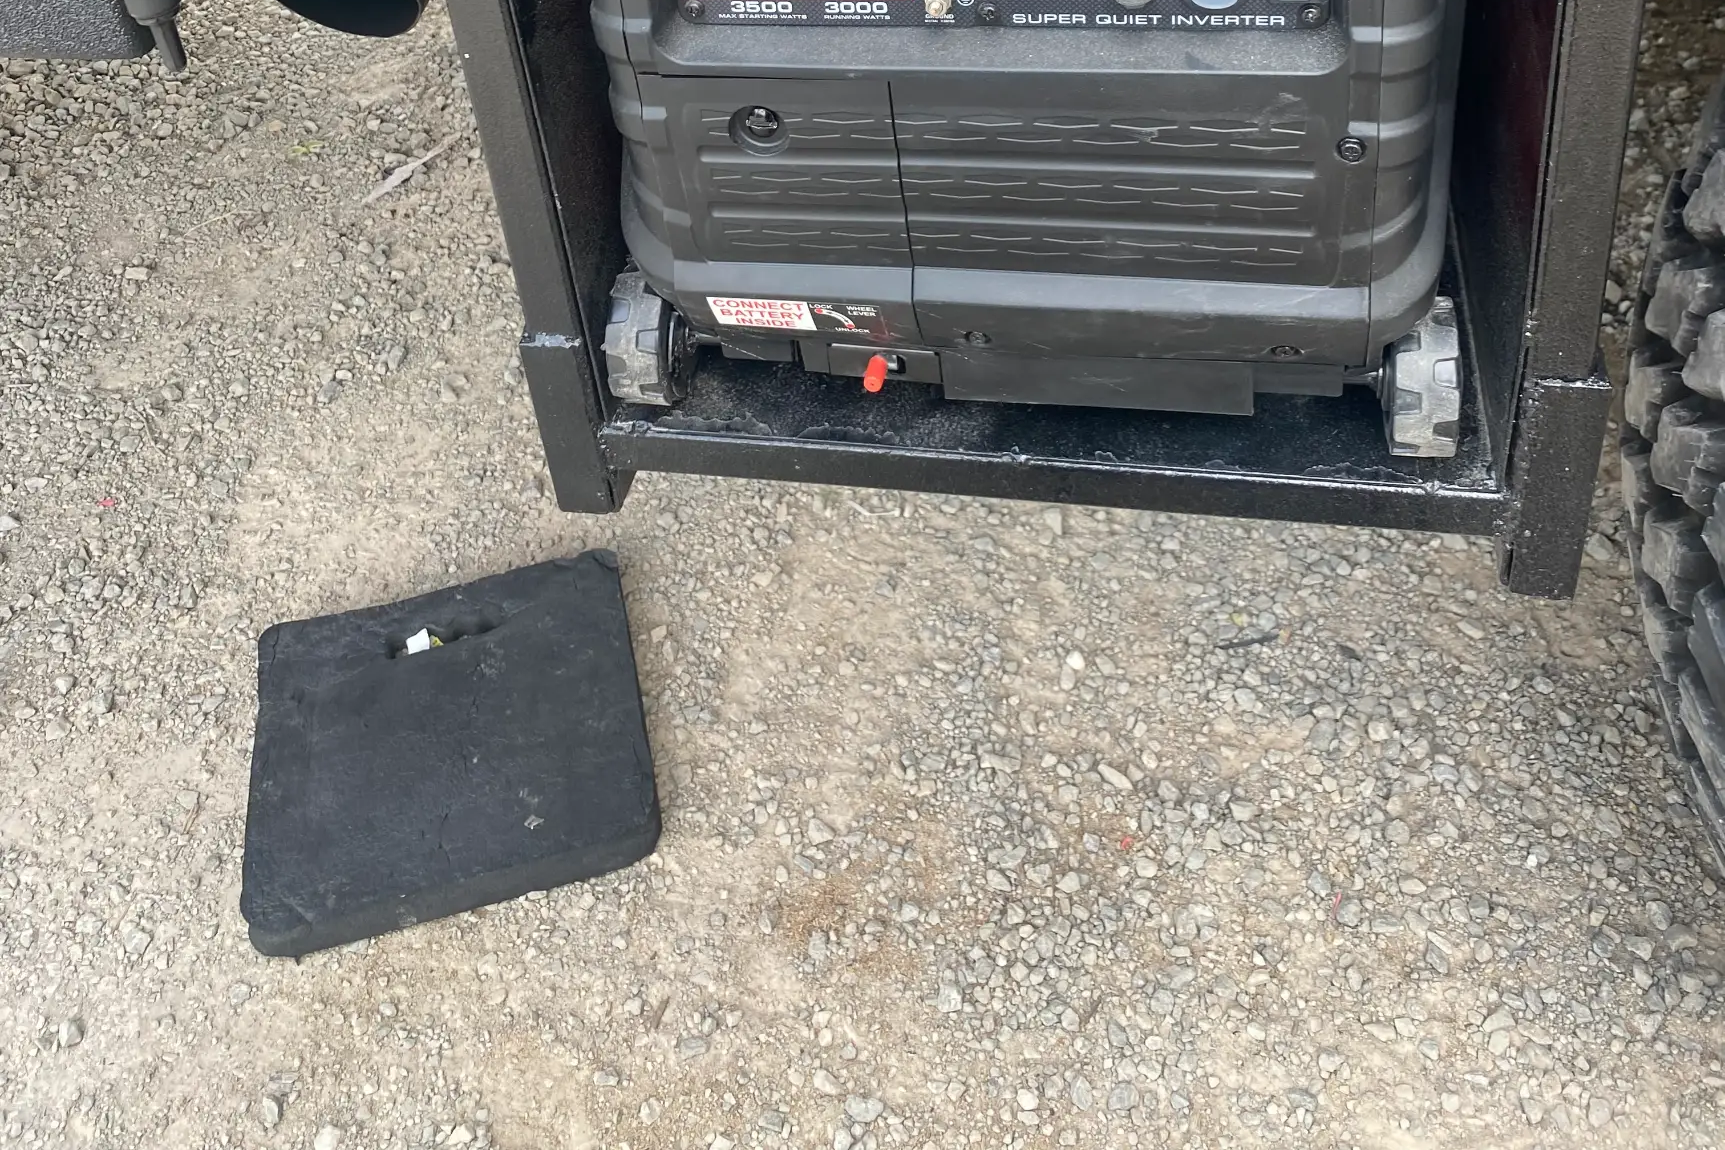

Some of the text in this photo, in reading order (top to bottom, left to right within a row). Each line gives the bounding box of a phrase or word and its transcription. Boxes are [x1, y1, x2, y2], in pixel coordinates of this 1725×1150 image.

[730, 1, 793, 13] 3500
[824, 1, 889, 14] 3000
[1012, 13, 1285, 26] SUPER QUIET INVERTER
[713, 299, 804, 311] CONNECT
[720, 308, 804, 321] BATTERY
[735, 317, 796, 328] INSIDE
